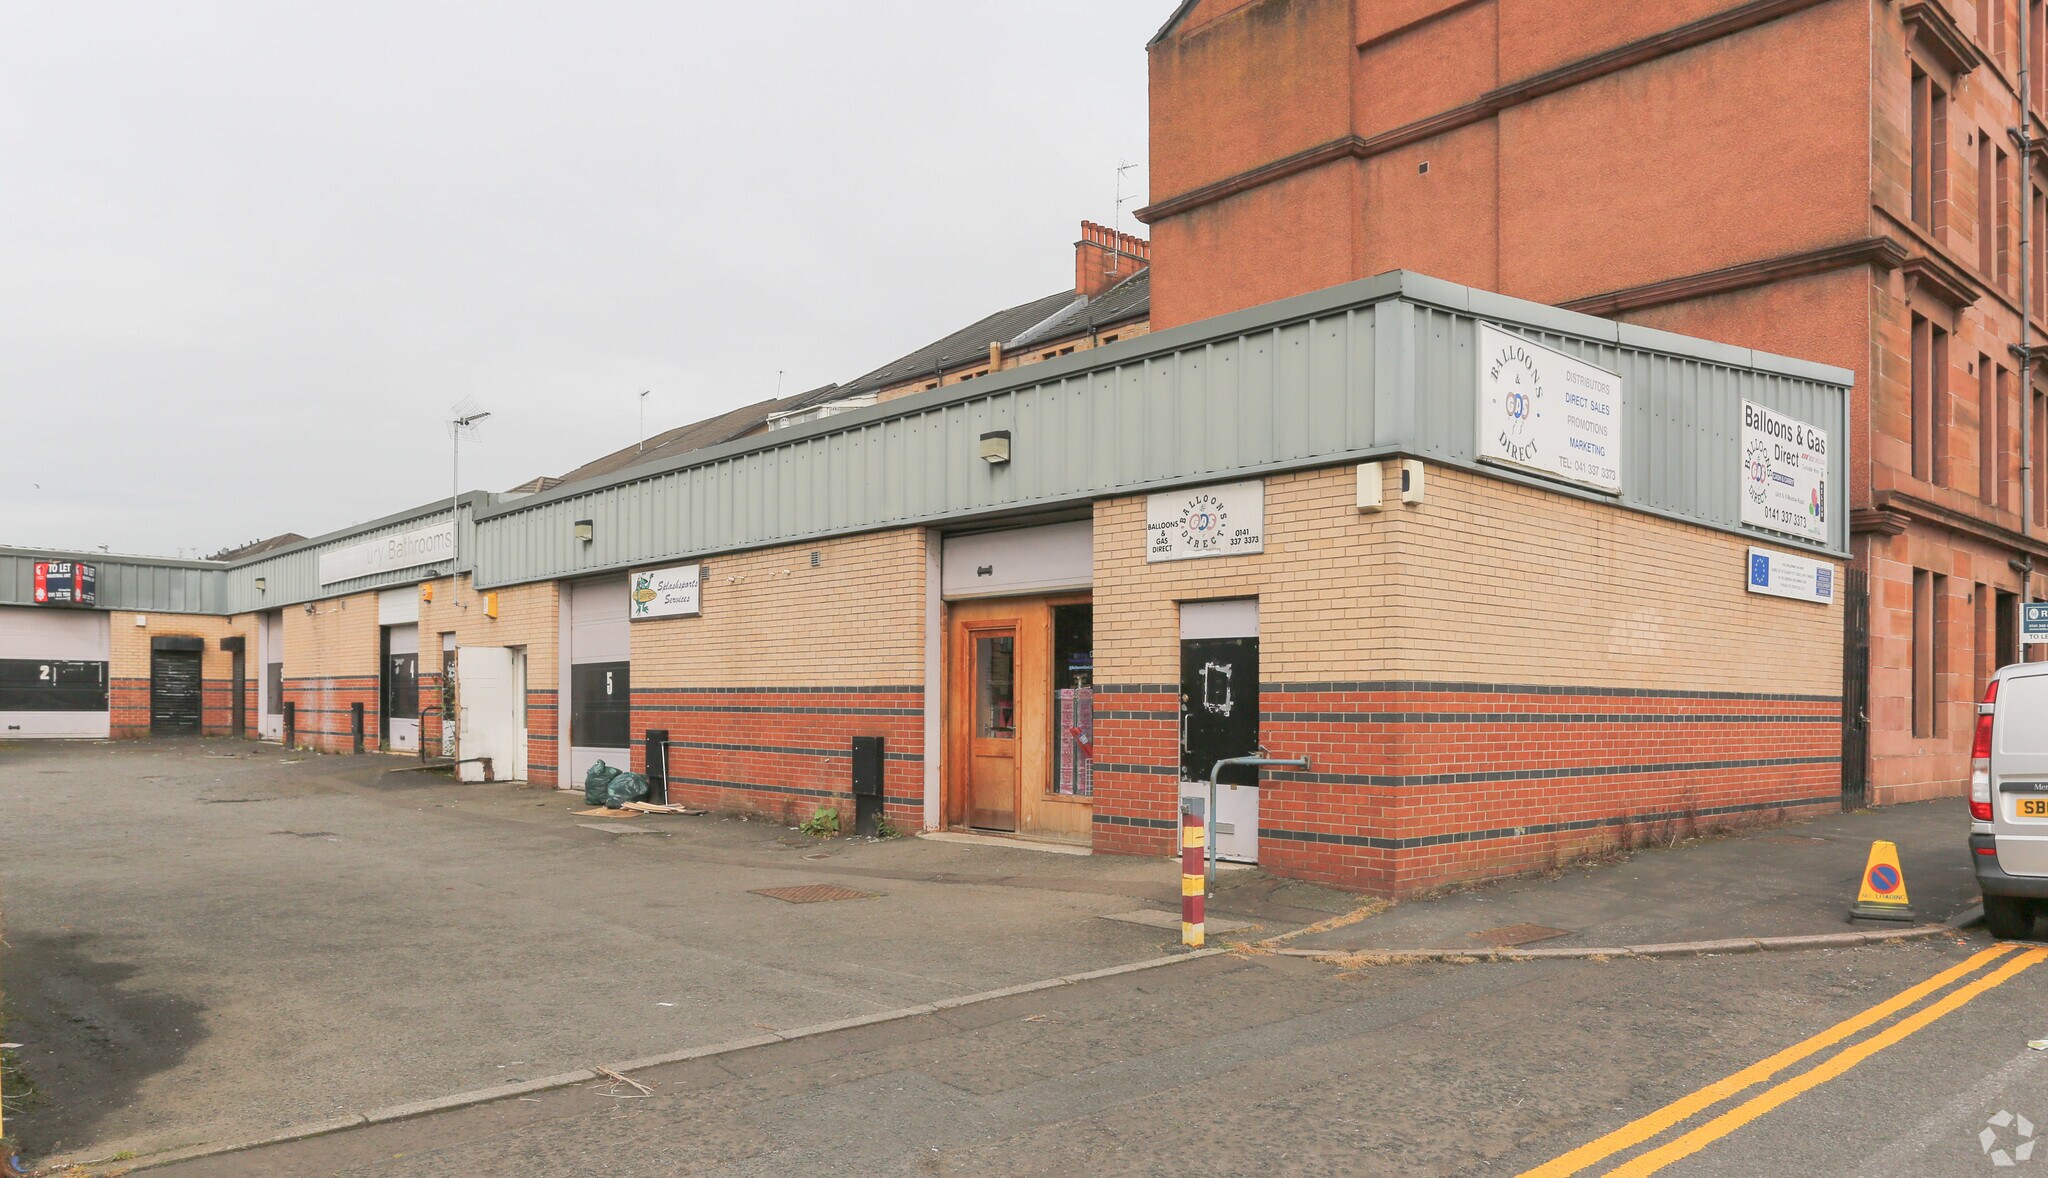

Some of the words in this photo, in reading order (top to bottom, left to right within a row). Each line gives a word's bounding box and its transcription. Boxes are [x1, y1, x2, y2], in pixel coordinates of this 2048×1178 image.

[1490, 345, 1543, 398] BALLOONS
[1566, 370, 1610, 395] DISTRIBUTORS
[1565, 392, 1588, 408] DIRECT
[1590, 400, 1610, 416] SALES
[1567, 414, 1608, 437] PROMOTIONS
[1745, 404, 1793, 443] Balloons
[1796, 425, 1803, 446] &
[1807, 429, 1825, 455] Gas
[1498, 431, 1538, 461] DIRECT
[1569, 437, 1606, 457] MARKETING
[1774, 443, 1799, 468] Direct
[1559, 455, 1572, 469] TEL:
[1574, 460, 1586, 473] 041
[1588, 463, 1599, 477] 337
[1601, 467, 1616, 481] 3373
[1179, 494, 1228, 524] BALLOONS
[1765, 505, 1779, 521] 0141
[1781, 510, 1793, 524] 337
[1794, 514, 1807, 529] 3373
[1147, 521, 1179, 531] BALLOONS
[1235, 528, 1249, 537] 0141
[389, 532, 452, 559] Bathrooms
[1156, 537, 1168, 545] GAS
[1182, 530, 1225, 548] DIRECT
[1230, 538, 1241, 546] 337
[1244, 536, 1259, 544] 3373
[1152, 545, 1173, 554] DIRECT
[48, 564, 58, 573] TO
[59, 563, 71, 573] LET
[657, 579, 698, 593] Splashsports
[664, 594, 690, 604] Services
[39, 664, 50, 680] 2
[409, 660, 415, 678] 4
[606, 671, 613, 695] 5
[2024, 800, 2048, 814] SB
